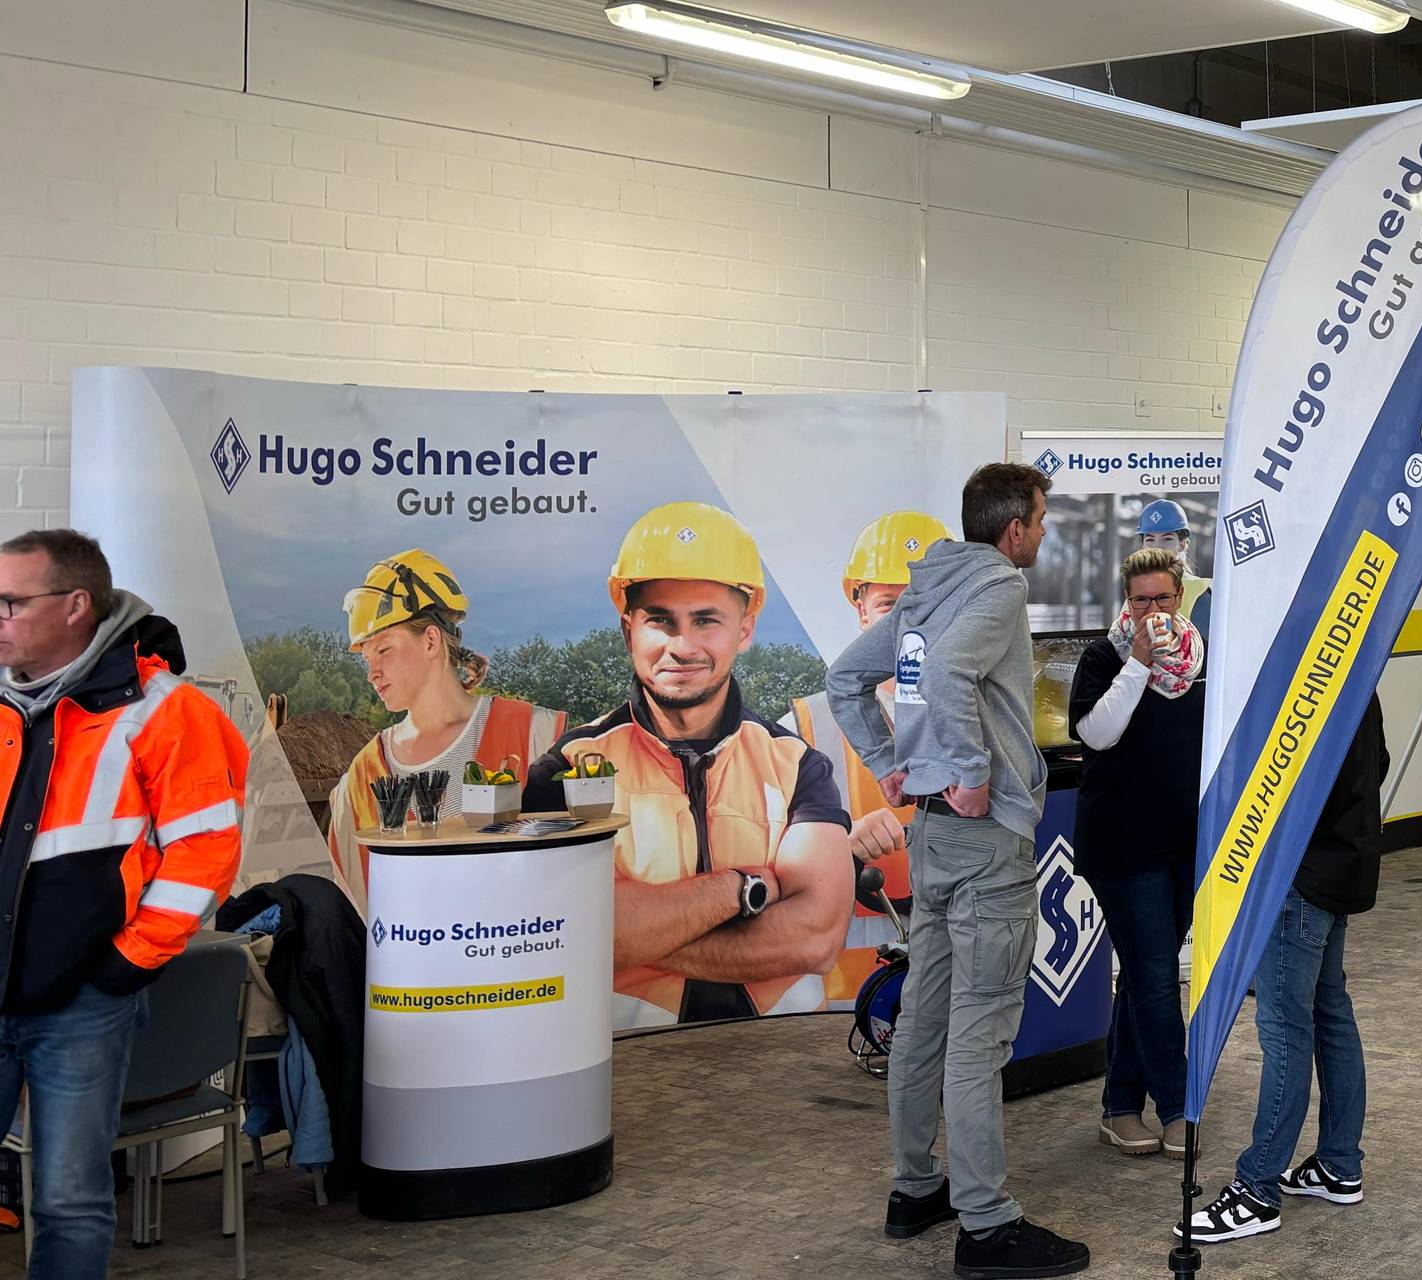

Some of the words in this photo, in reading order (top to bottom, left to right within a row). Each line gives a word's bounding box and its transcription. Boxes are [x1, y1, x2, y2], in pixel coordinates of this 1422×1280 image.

[1368, 274, 1415, 340] Gut
[1254, 362, 1331, 493] Hugo
[259, 434, 361, 485] Hugo
[372, 437, 597, 476] Schneider
[1069, 454, 1122, 473] Hugo
[1128, 452, 1222, 469] Schneider
[1140, 474, 1165, 486] Gut
[397, 488, 454, 516] Gut
[467, 487, 597, 522] gebaut.
[1219, 550, 1385, 884] WWW.HUGOSCHNEIDER.DE
[391, 924, 446, 945] Hugo
[451, 917, 565, 940] Schneider
[465, 944, 496, 958] Gut
[501, 938, 564, 958] gebaut.
[373, 984, 557, 1010] www.hugoschneider.de
